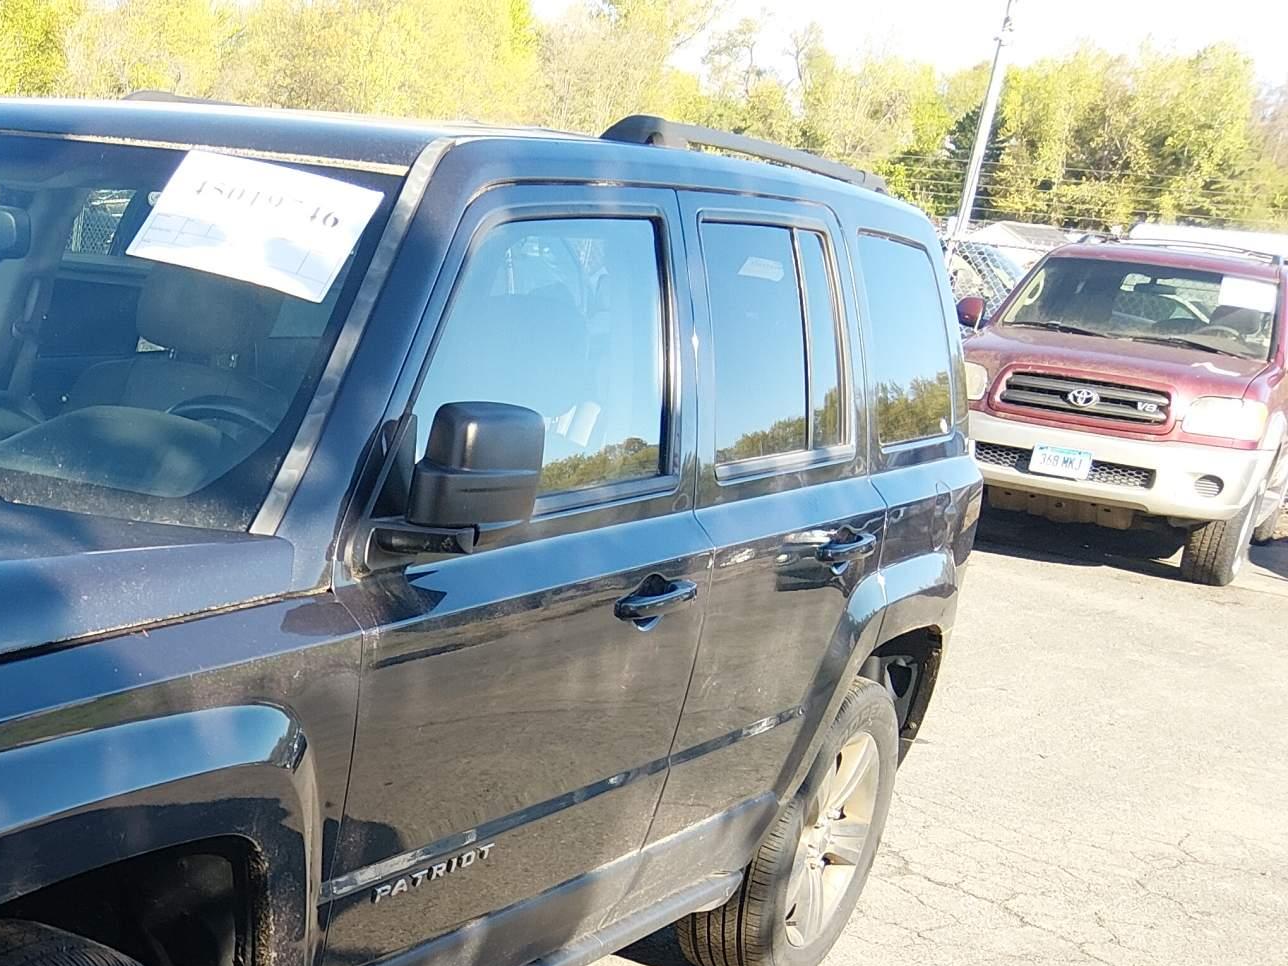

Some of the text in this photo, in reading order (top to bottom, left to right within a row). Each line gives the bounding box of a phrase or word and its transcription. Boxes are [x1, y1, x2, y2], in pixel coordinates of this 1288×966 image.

[194, 180, 340, 229] 4501946
[1136, 401, 1158, 412] V8
[370, 842, 496, 904] PATRIOT
